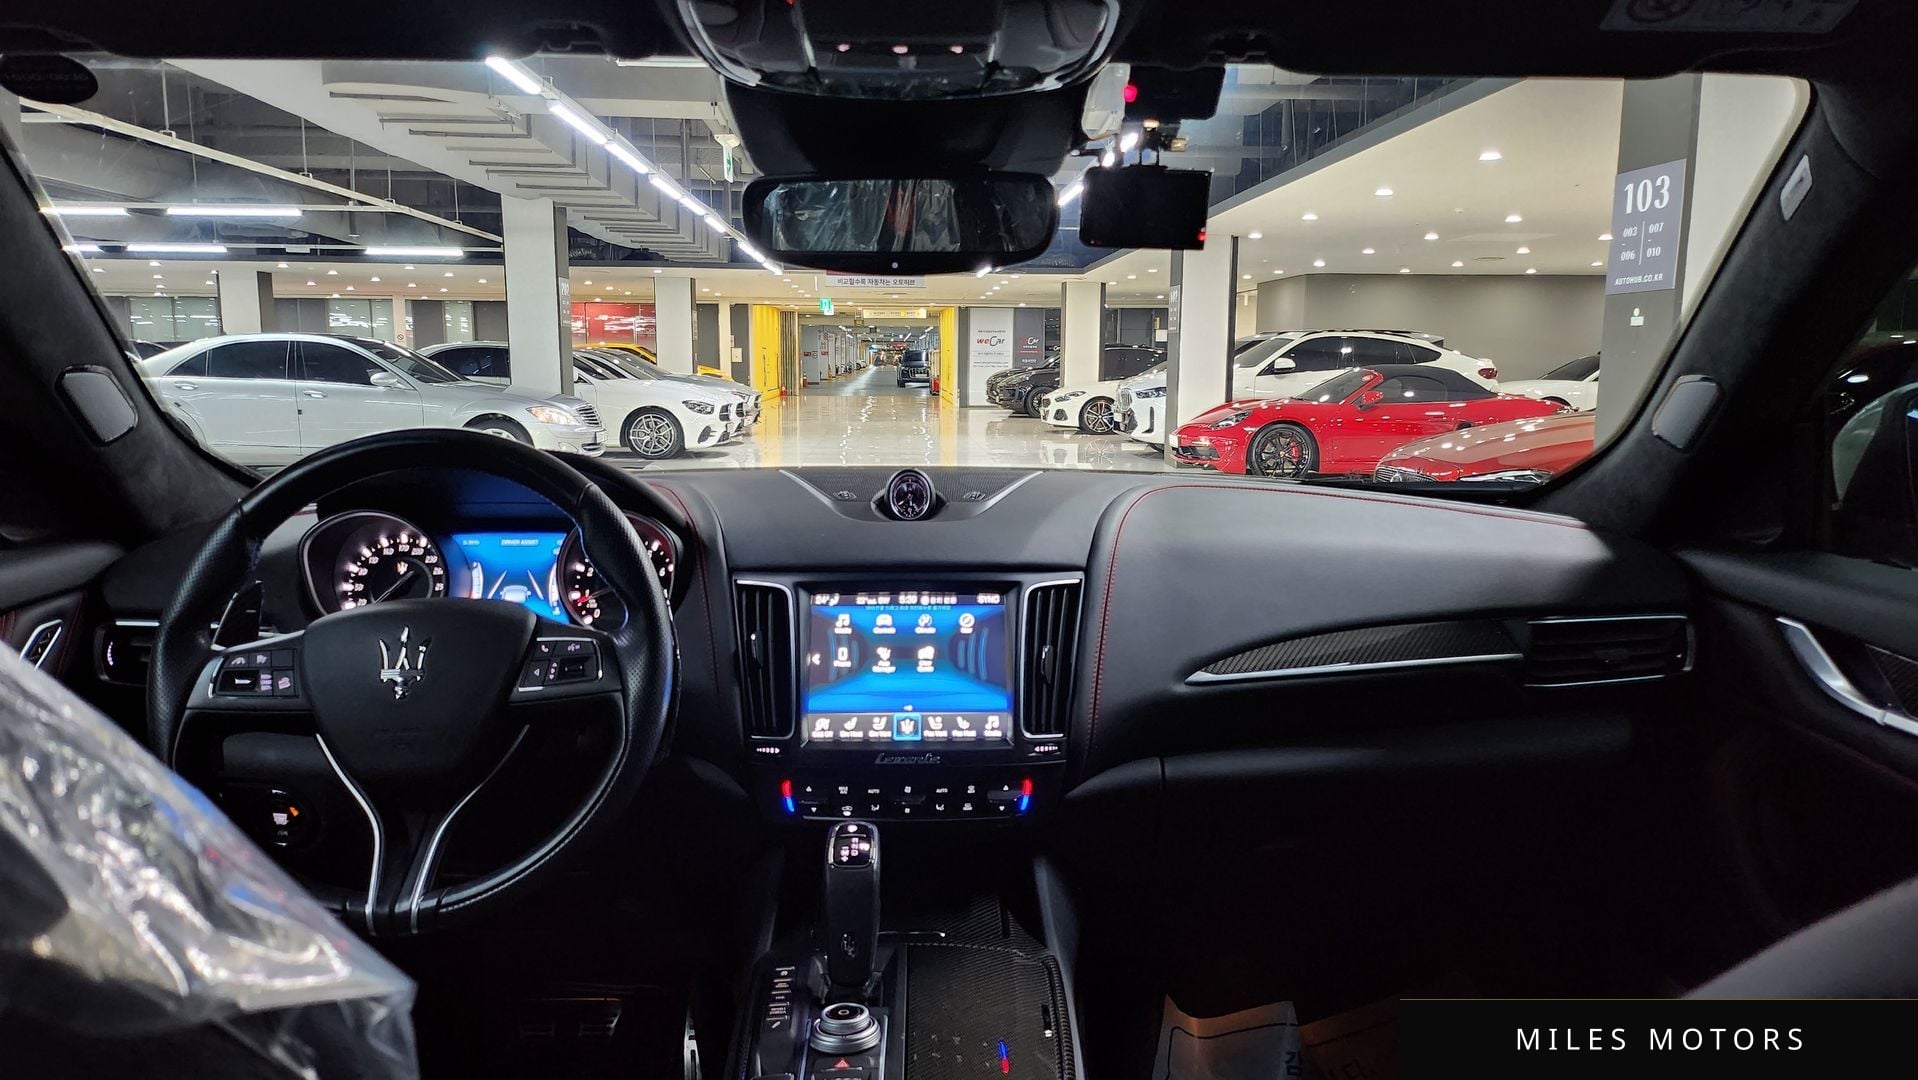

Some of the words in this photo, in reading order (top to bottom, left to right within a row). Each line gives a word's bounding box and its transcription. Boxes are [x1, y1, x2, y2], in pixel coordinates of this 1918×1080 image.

[1624, 175, 1670, 214] 103
[1622, 226, 1638, 238] 003
[1648, 222, 1664, 234] 007
[1620, 250, 1636, 261] 006
[1646, 246, 1661, 258] 010
[837, 278, 866, 286] 비교할수록
[867, 278, 891, 286] 자동차는
[1614, 273, 1663, 286] AUTOHUB.CO.KR
[425, 555, 438, 563] 230
[586, 567, 593, 577] 2
[659, 567, 666, 576] 6
[977, 594, 1000, 604] SYNC
[593, 609, 600, 618] 0
